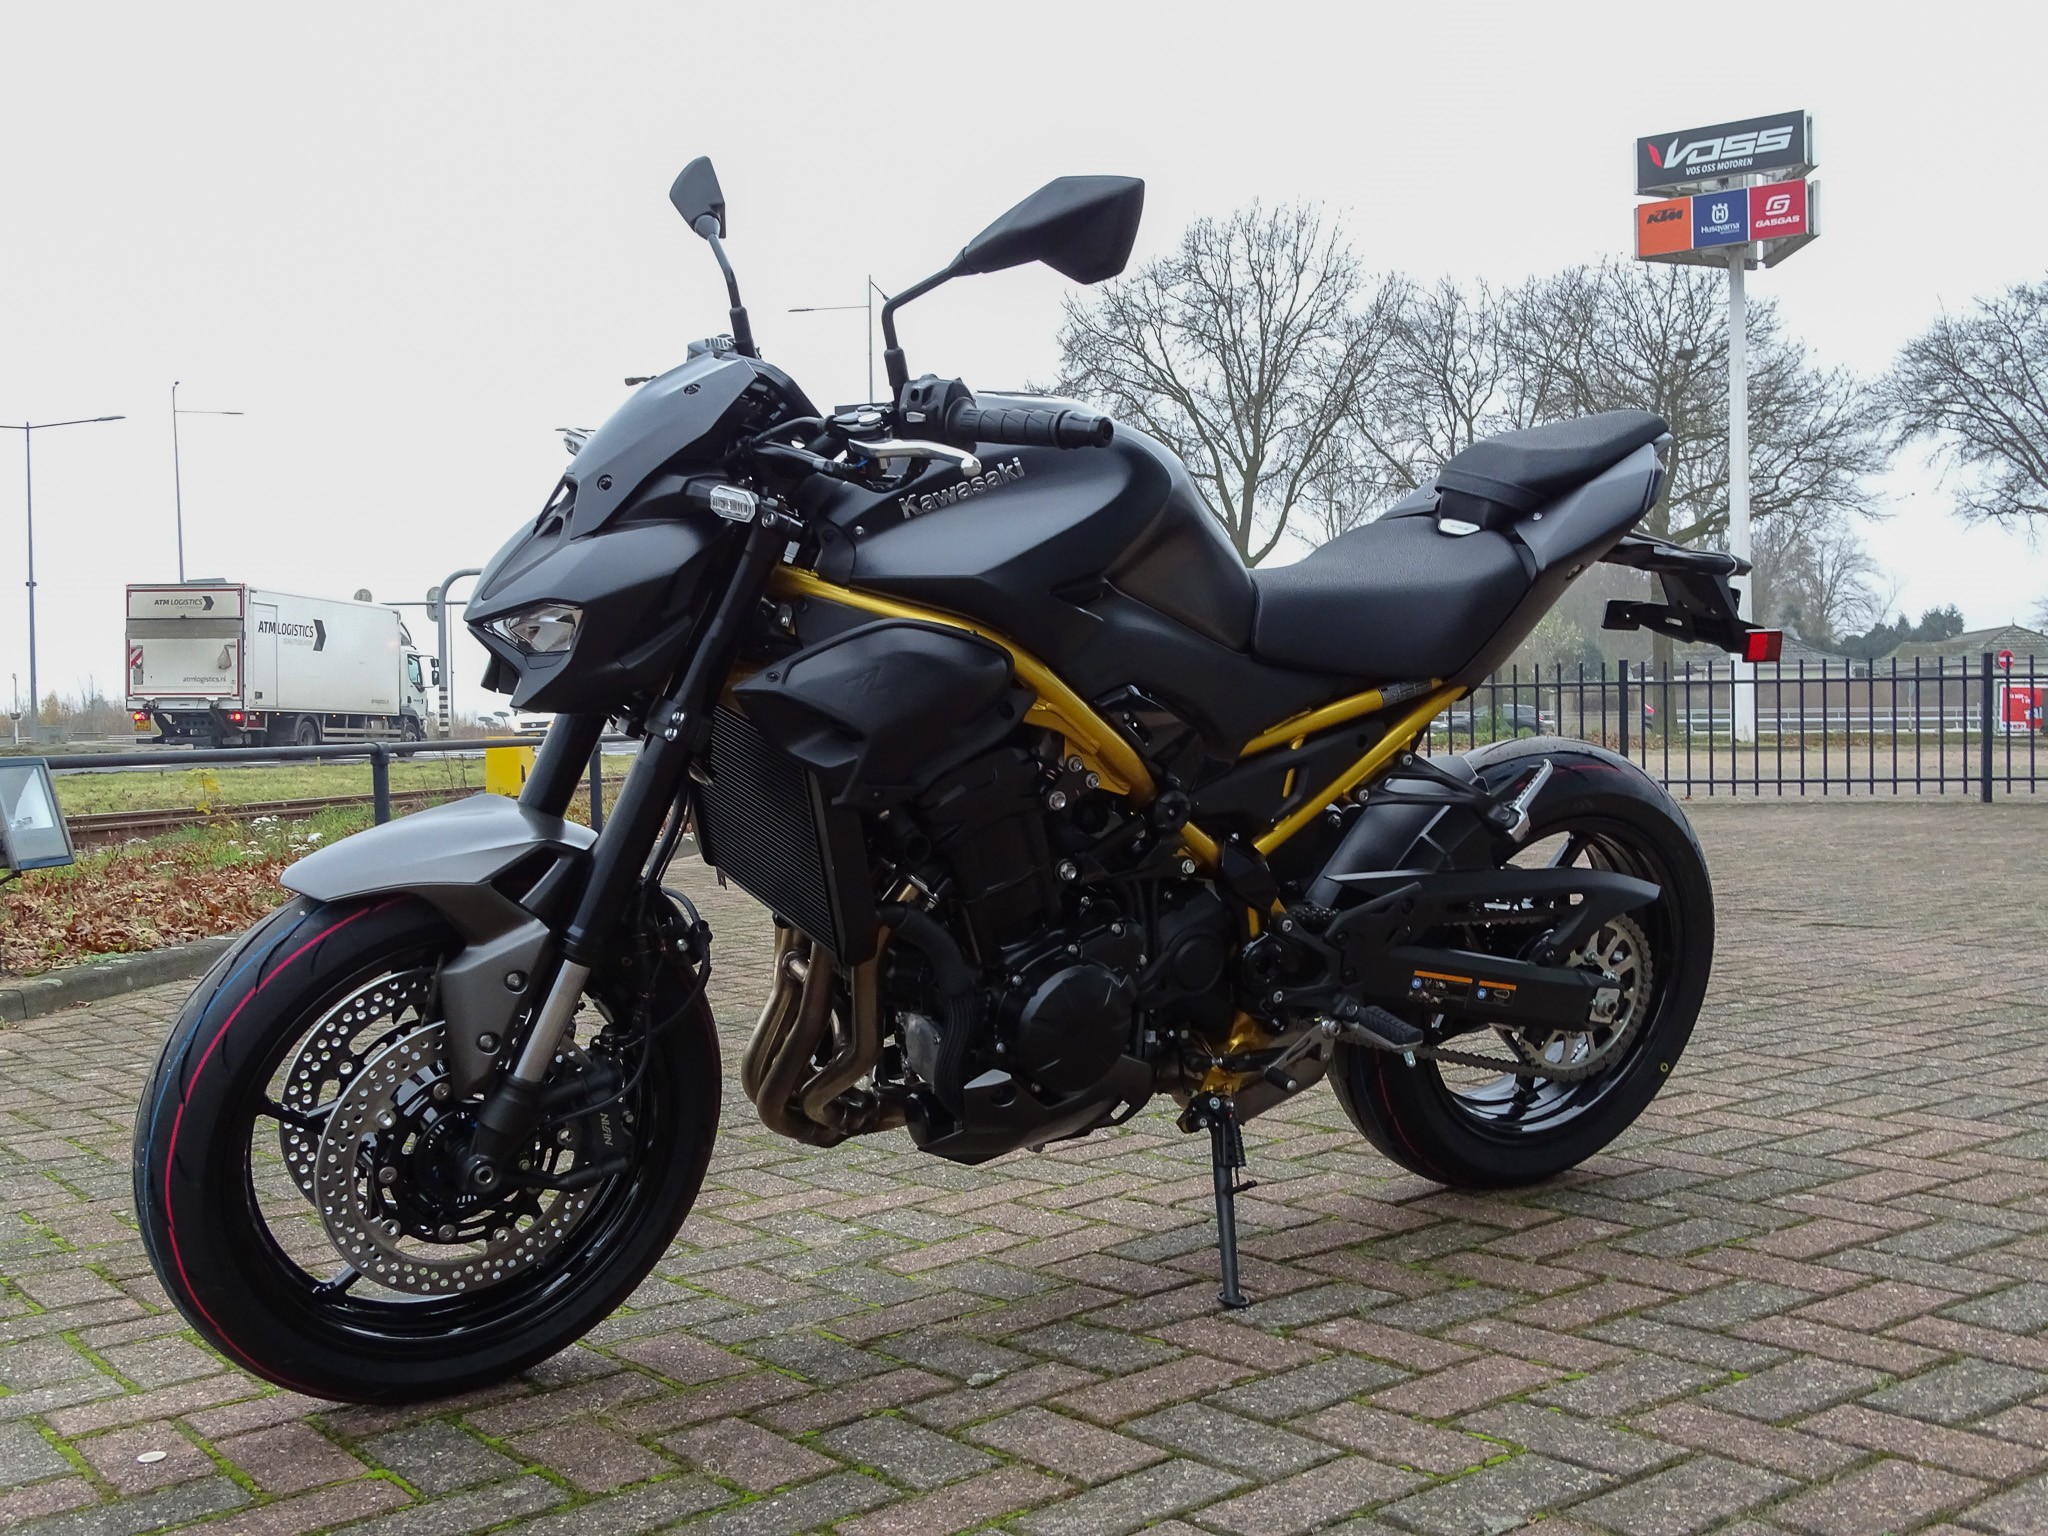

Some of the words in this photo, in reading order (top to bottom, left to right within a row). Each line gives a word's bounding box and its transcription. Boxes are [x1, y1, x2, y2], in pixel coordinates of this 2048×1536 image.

[1648, 126, 1793, 169] VOSS
[1685, 165, 1701, 176] VOS
[1701, 163, 1716, 173] OSS
[1717, 157, 1753, 171] MOTOREN
[1647, 208, 1683, 224] KTM
[1755, 215, 1800, 228] GASGAS
[1701, 222, 1740, 234] Husqvarna
[898, 456, 1025, 519] Kawasaki
[170, 598, 203, 606] LOGISTICS
[257, 620, 276, 634] ATM
[277, 622, 314, 638] LOGISTICS
[182, 675, 227, 684] atmlogistics.nl
